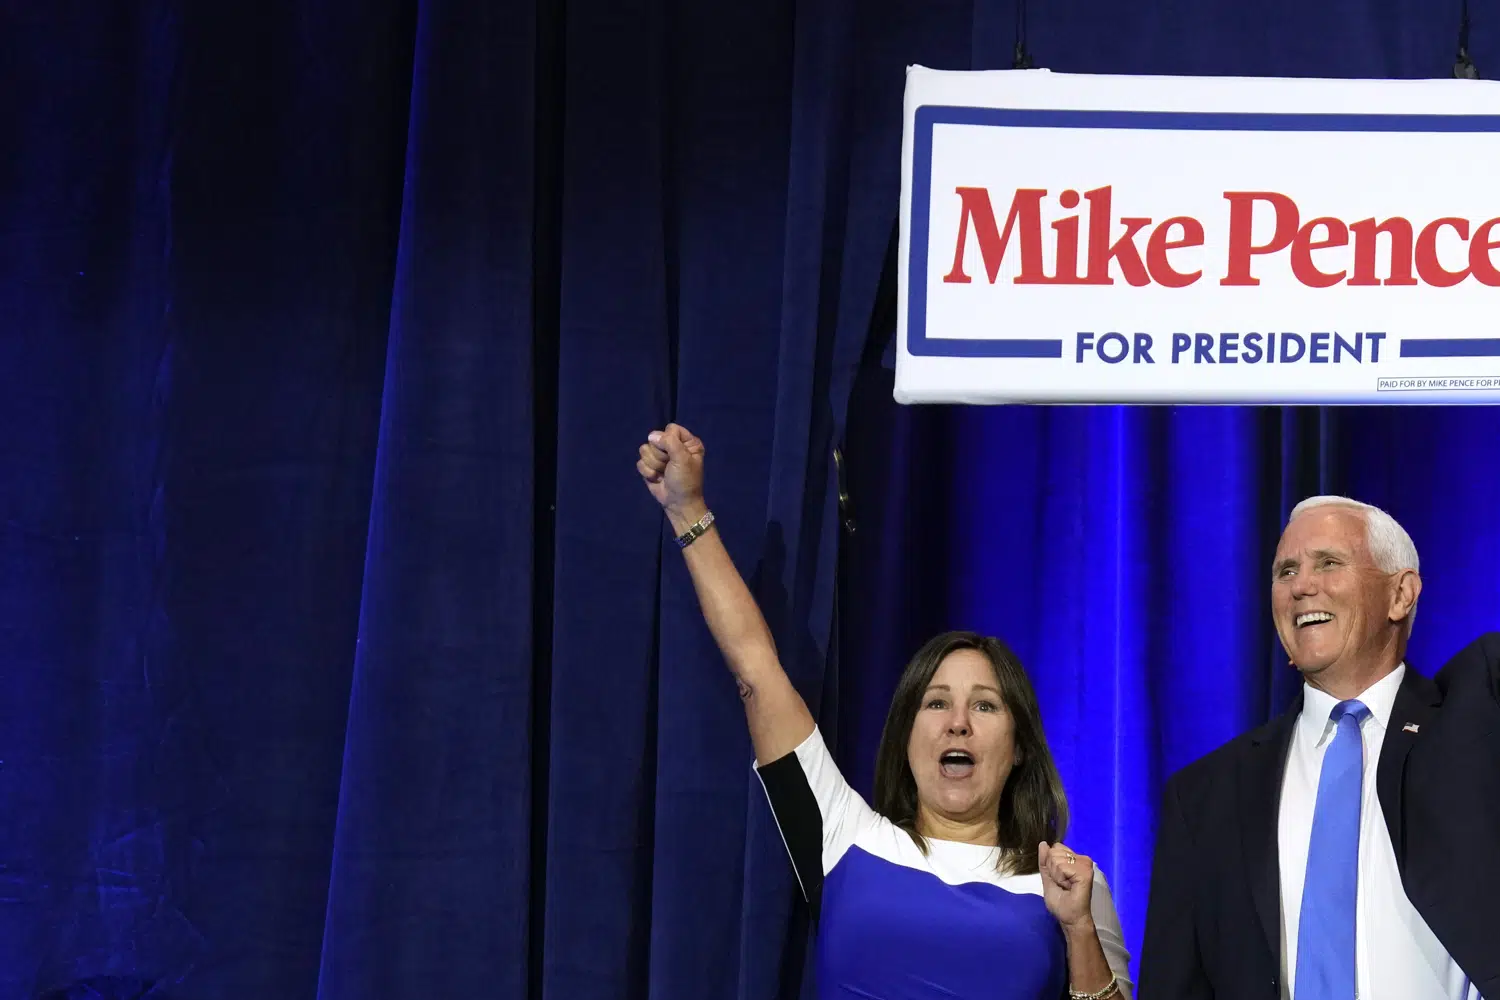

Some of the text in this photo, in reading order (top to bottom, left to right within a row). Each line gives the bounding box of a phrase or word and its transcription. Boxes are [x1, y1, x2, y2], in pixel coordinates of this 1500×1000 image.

[943, 185, 1205, 287] Mike
[1075, 331, 1387, 364] FOR PRESIDENT
[1380, 380, 1398, 388] PAID
[1400, 380, 1415, 388] FOR
[1450, 379, 1474, 387] PENCE
